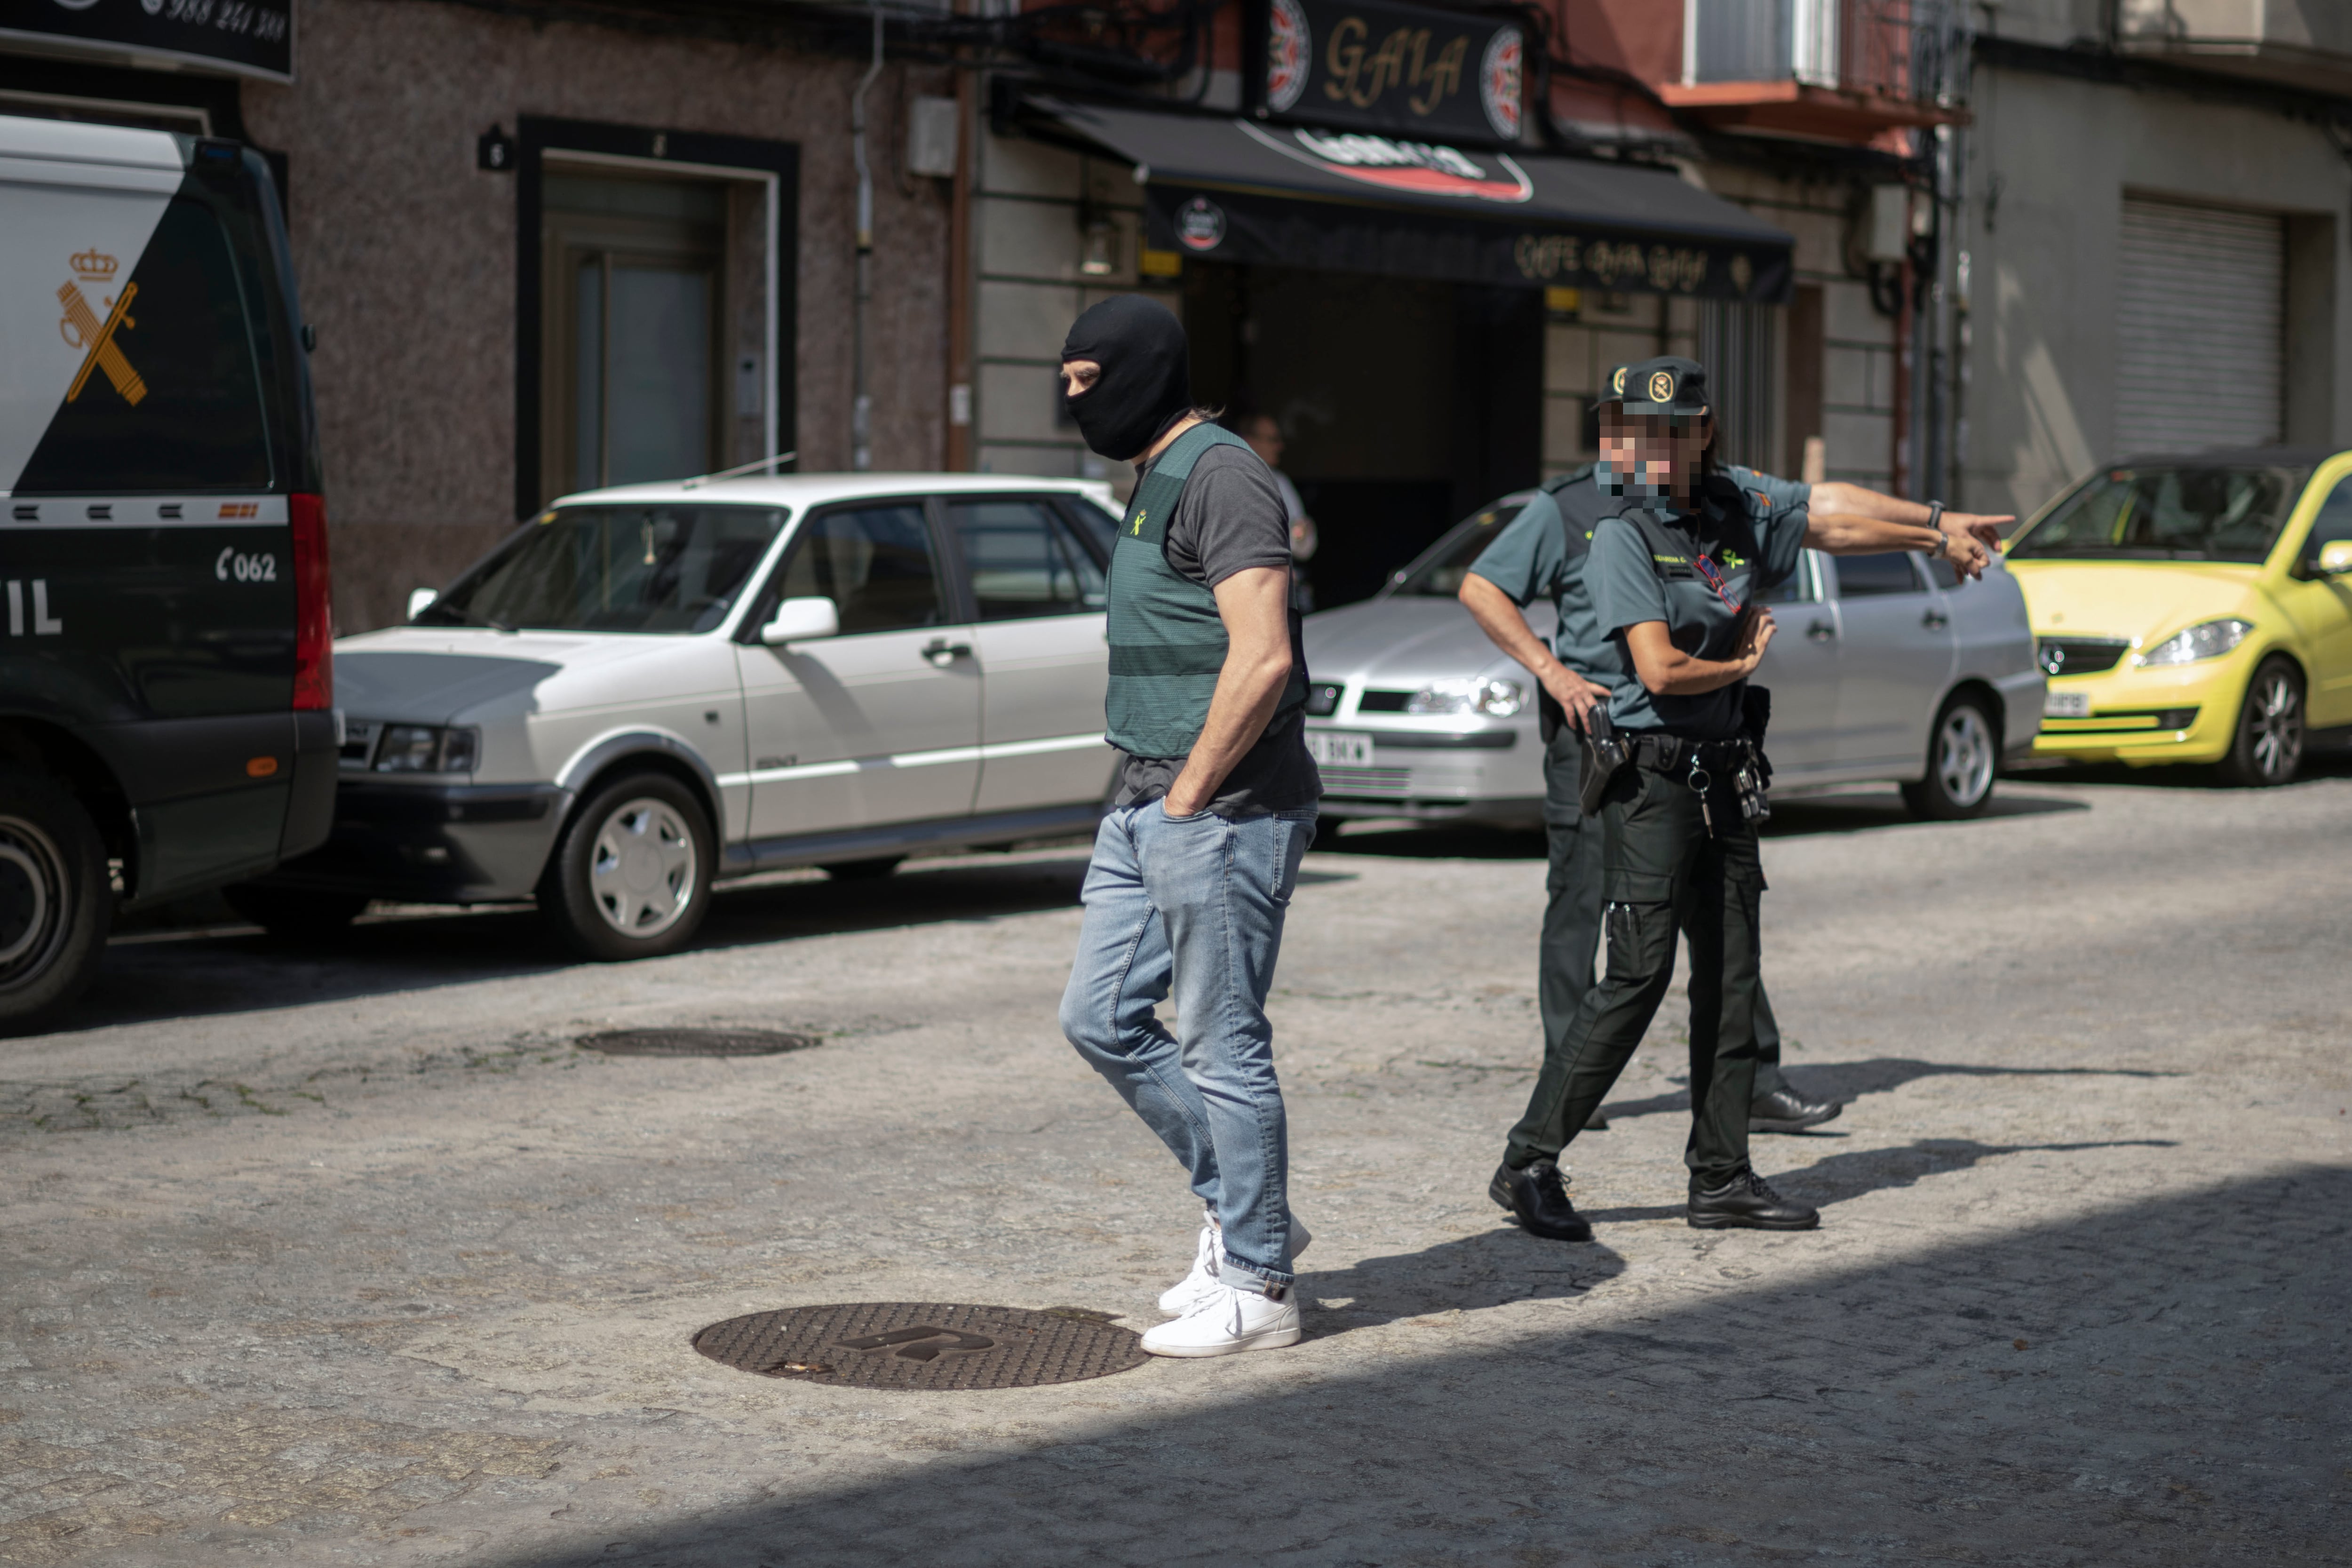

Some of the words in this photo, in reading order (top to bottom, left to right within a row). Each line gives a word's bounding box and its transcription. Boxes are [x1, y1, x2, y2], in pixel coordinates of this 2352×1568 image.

[1324, 17, 1469, 115] GAIA
[234, 552, 277, 582] 062
[0, 579, 62, 637] IL
